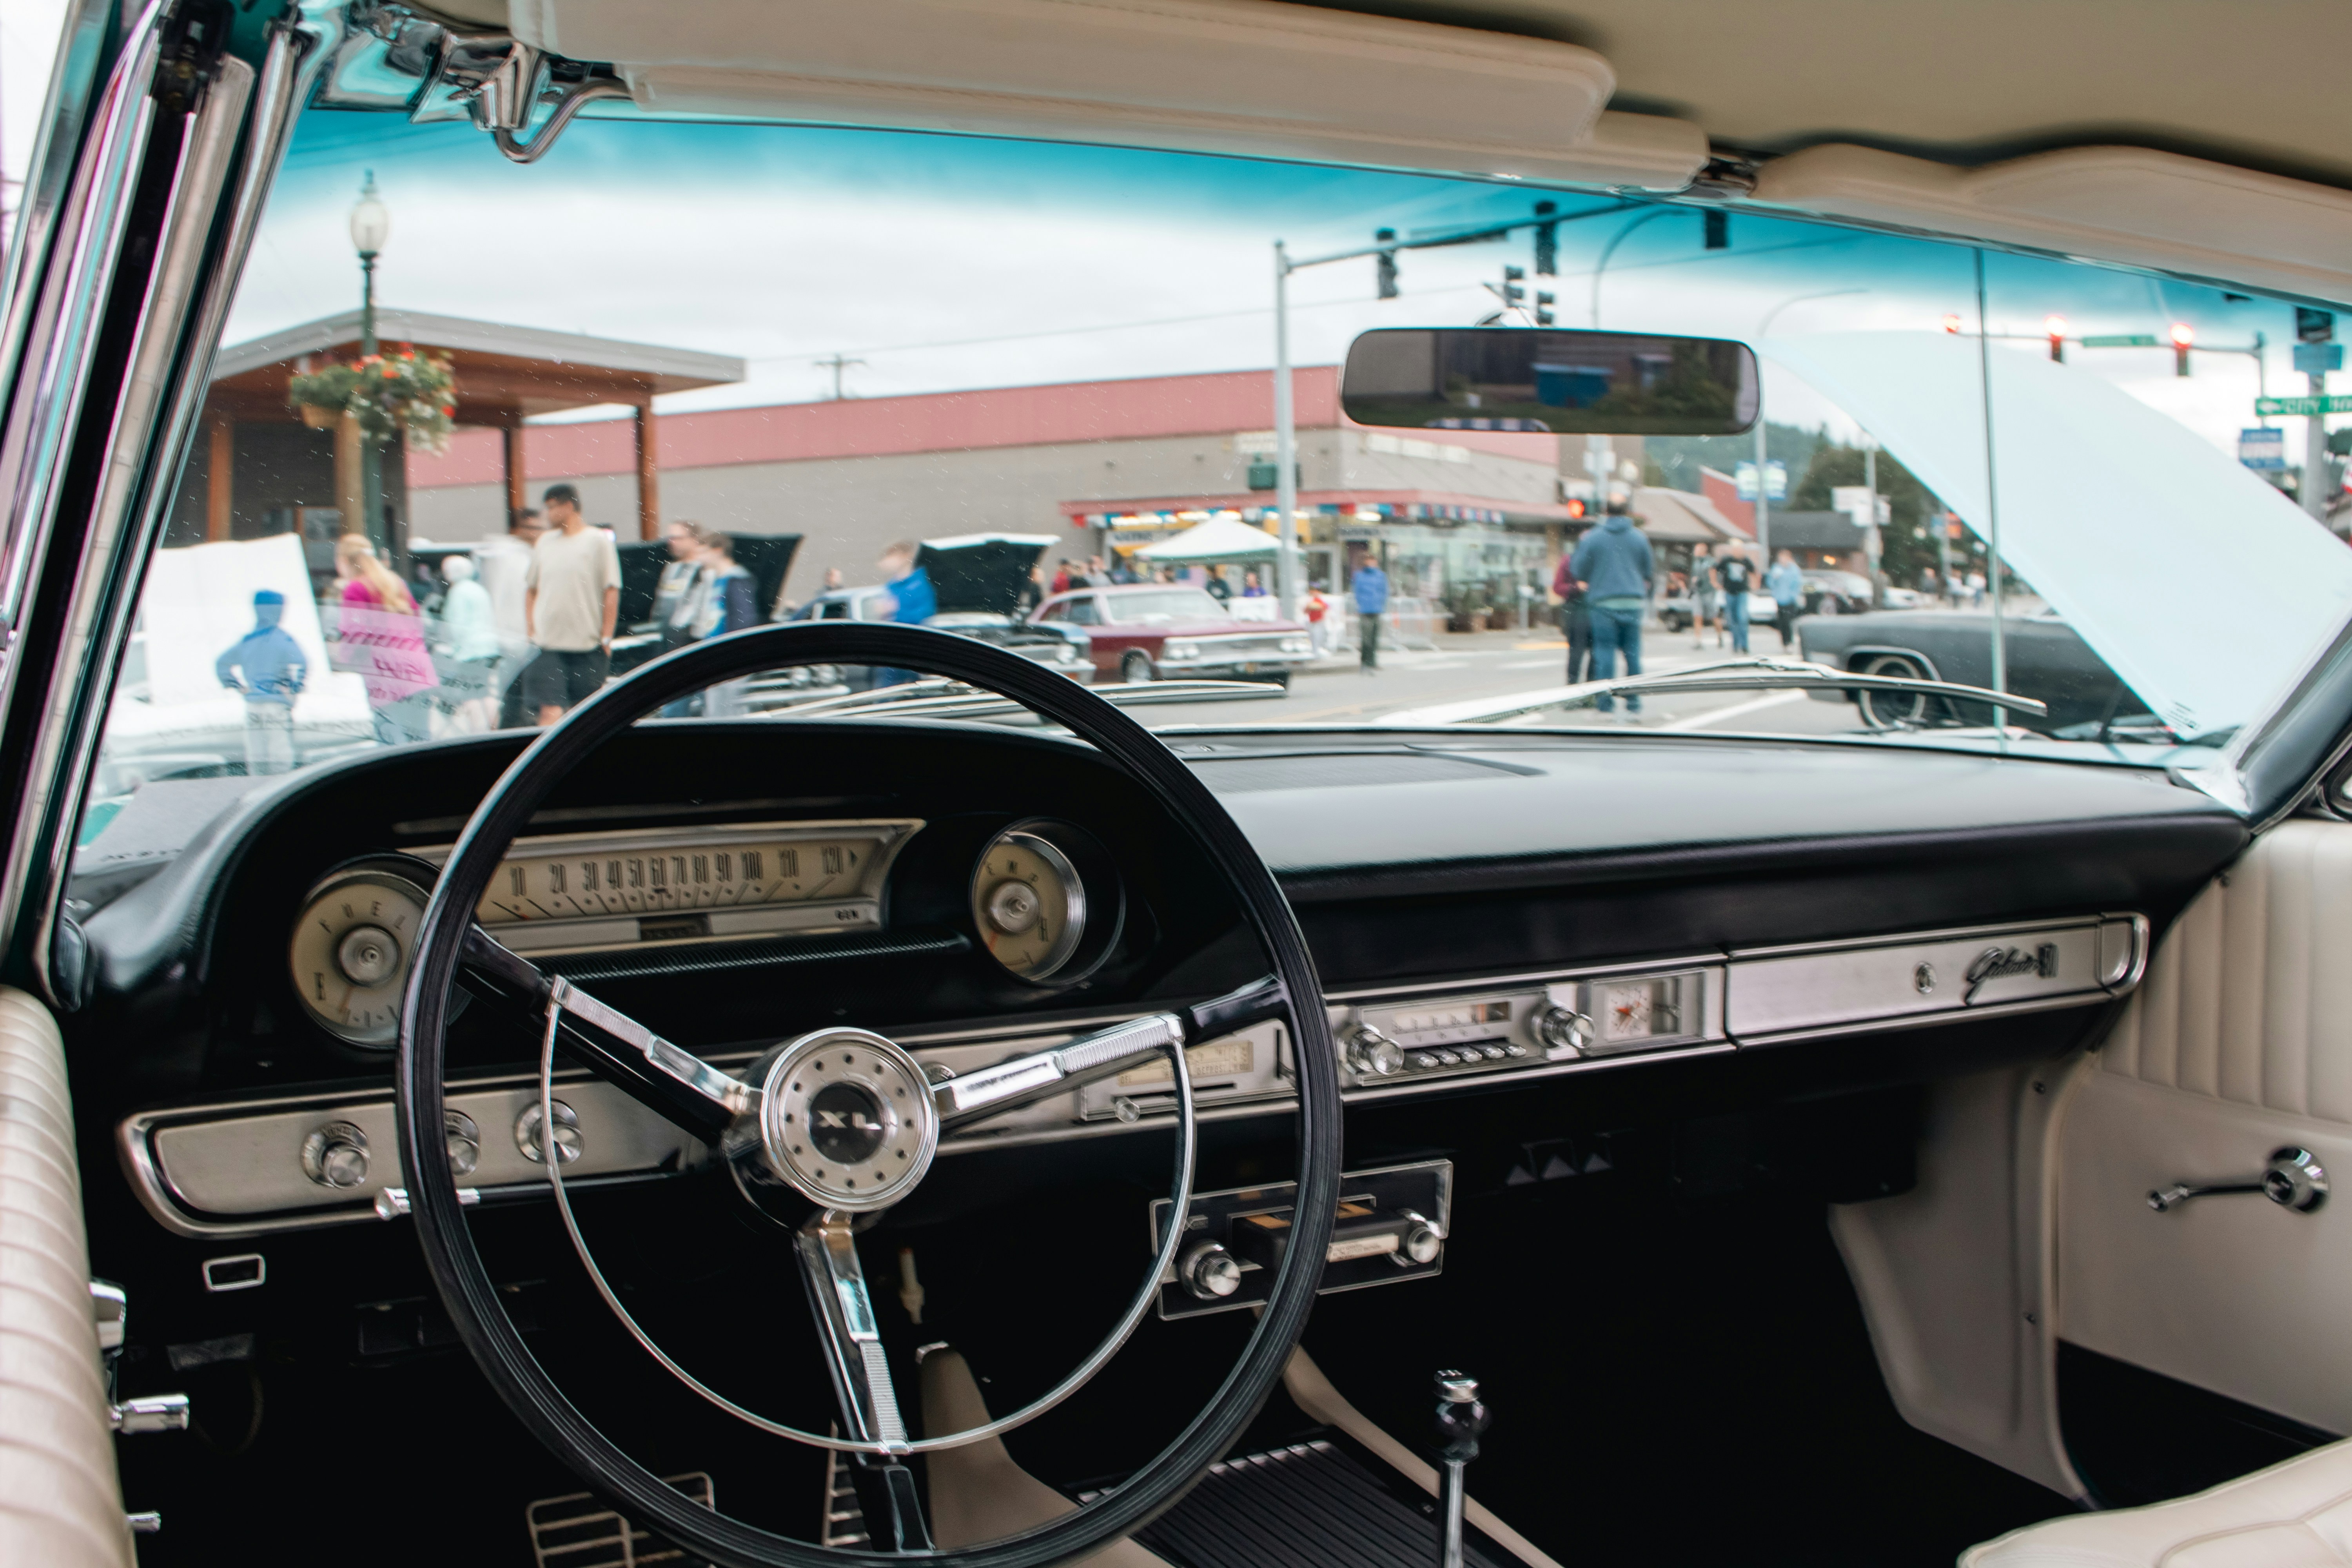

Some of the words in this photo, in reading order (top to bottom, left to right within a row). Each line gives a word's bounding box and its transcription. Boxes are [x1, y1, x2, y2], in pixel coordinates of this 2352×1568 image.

[511, 866, 526, 897] 10
[550, 864, 567, 893] 20
[582, 862, 600, 891] 30
[606, 860, 623, 889] 40
[629, 858, 645, 888] 50
[650, 857, 667, 886] 60
[670, 855, 687, 885] 70
[692, 854, 710, 884] 80
[715, 853, 731, 882] 90
[742, 851, 763, 880] 100
[779, 849, 799, 877] 110
[822, 846, 844, 875] 120
[817, 1110, 882, 1130] XL
